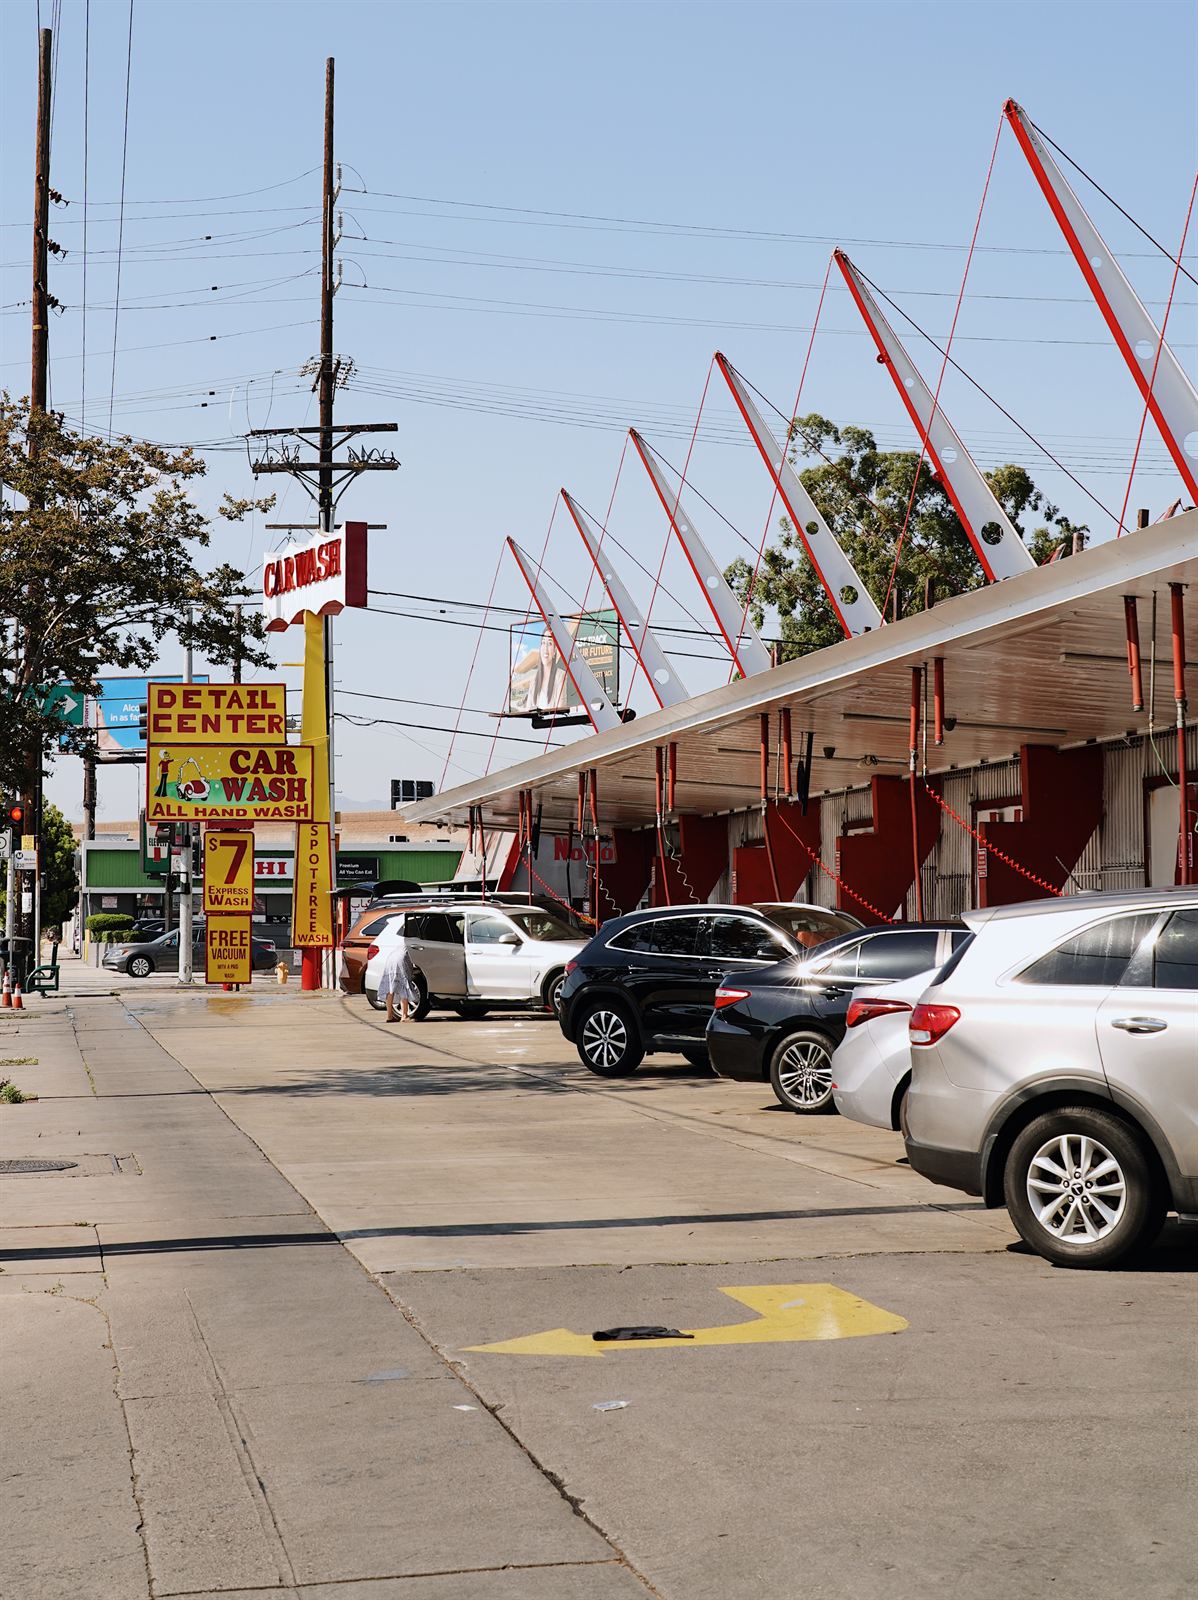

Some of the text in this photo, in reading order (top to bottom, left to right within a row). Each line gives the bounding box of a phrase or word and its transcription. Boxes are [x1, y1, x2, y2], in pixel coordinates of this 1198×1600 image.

[264, 538, 342, 598] CAR WASH
[157, 690, 276, 709] DETAIL
[152, 714, 283, 733] CENTER
[229, 749, 298, 775] CAR
[220, 777, 307, 802] WASH
[152, 802, 309, 818] ALL HAND WASH
[208, 885, 249, 895] EXPRESS
[208, 894, 249, 906] WASH
[209, 930, 249, 947] FREE
[297, 934, 329, 943] WASH
[211, 948, 247, 960] VACUUM
